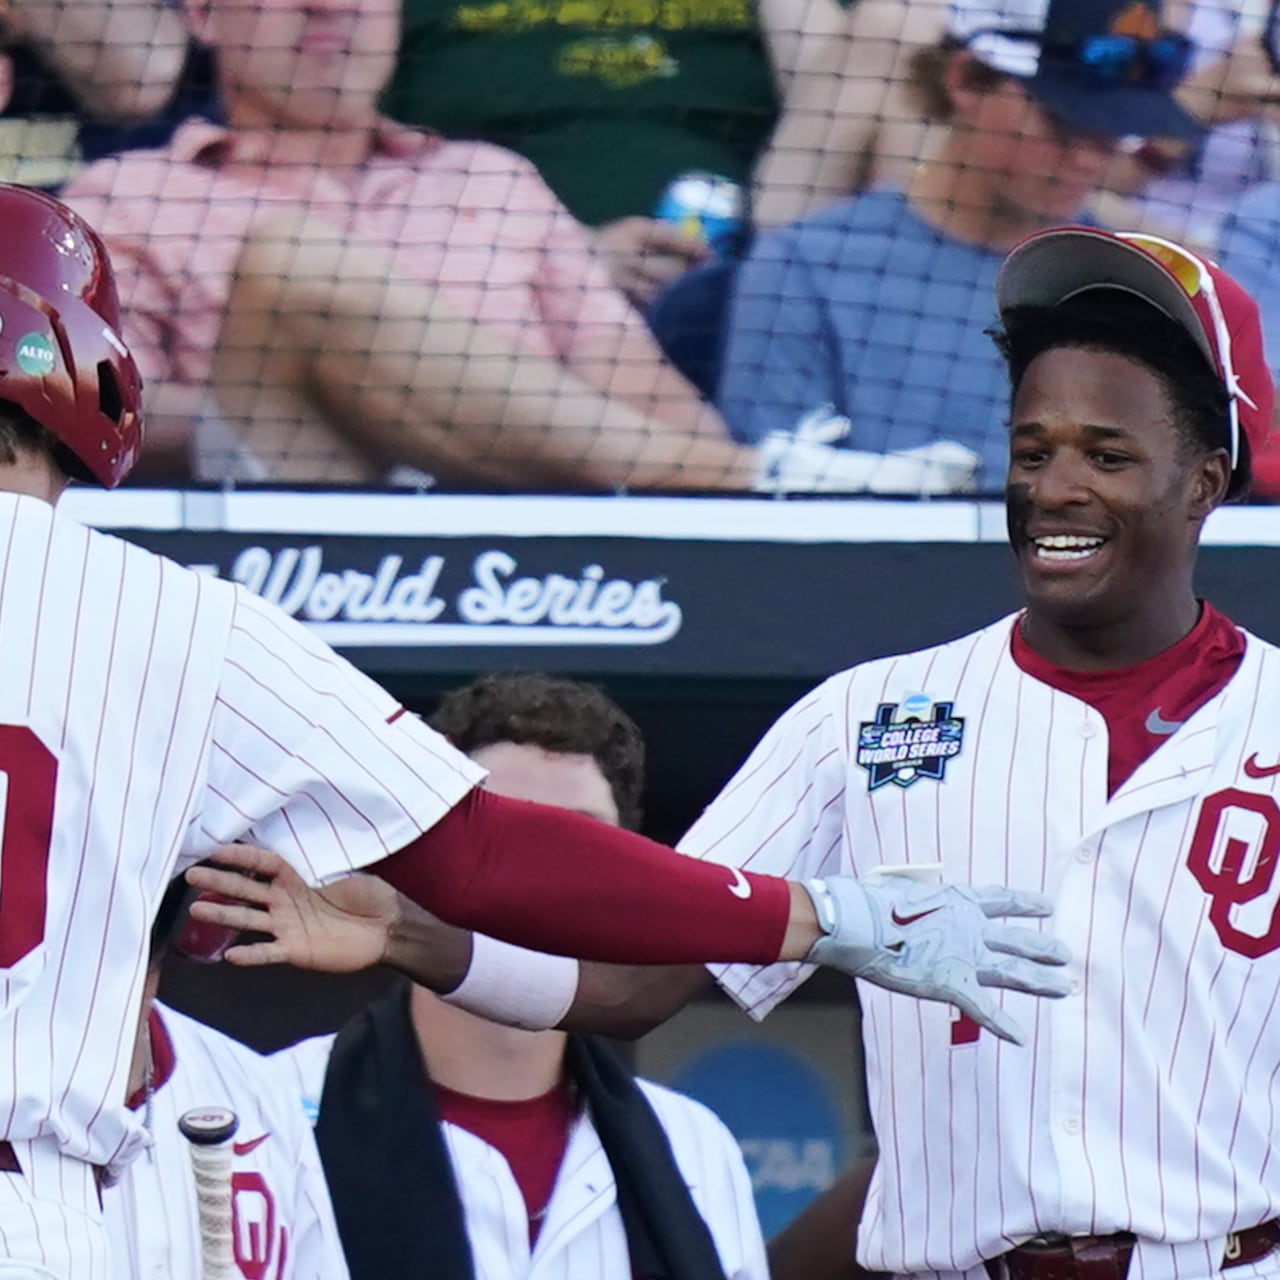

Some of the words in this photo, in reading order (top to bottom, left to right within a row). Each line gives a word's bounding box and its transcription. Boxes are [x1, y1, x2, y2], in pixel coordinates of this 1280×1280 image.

[19, 345, 54, 361] ALTO
[233, 546, 445, 623] World
[458, 550, 667, 627] Series
[881, 728, 941, 748] COLLEGE
[858, 745, 908, 764] WORLD
[908, 741, 960, 759] SERIES
